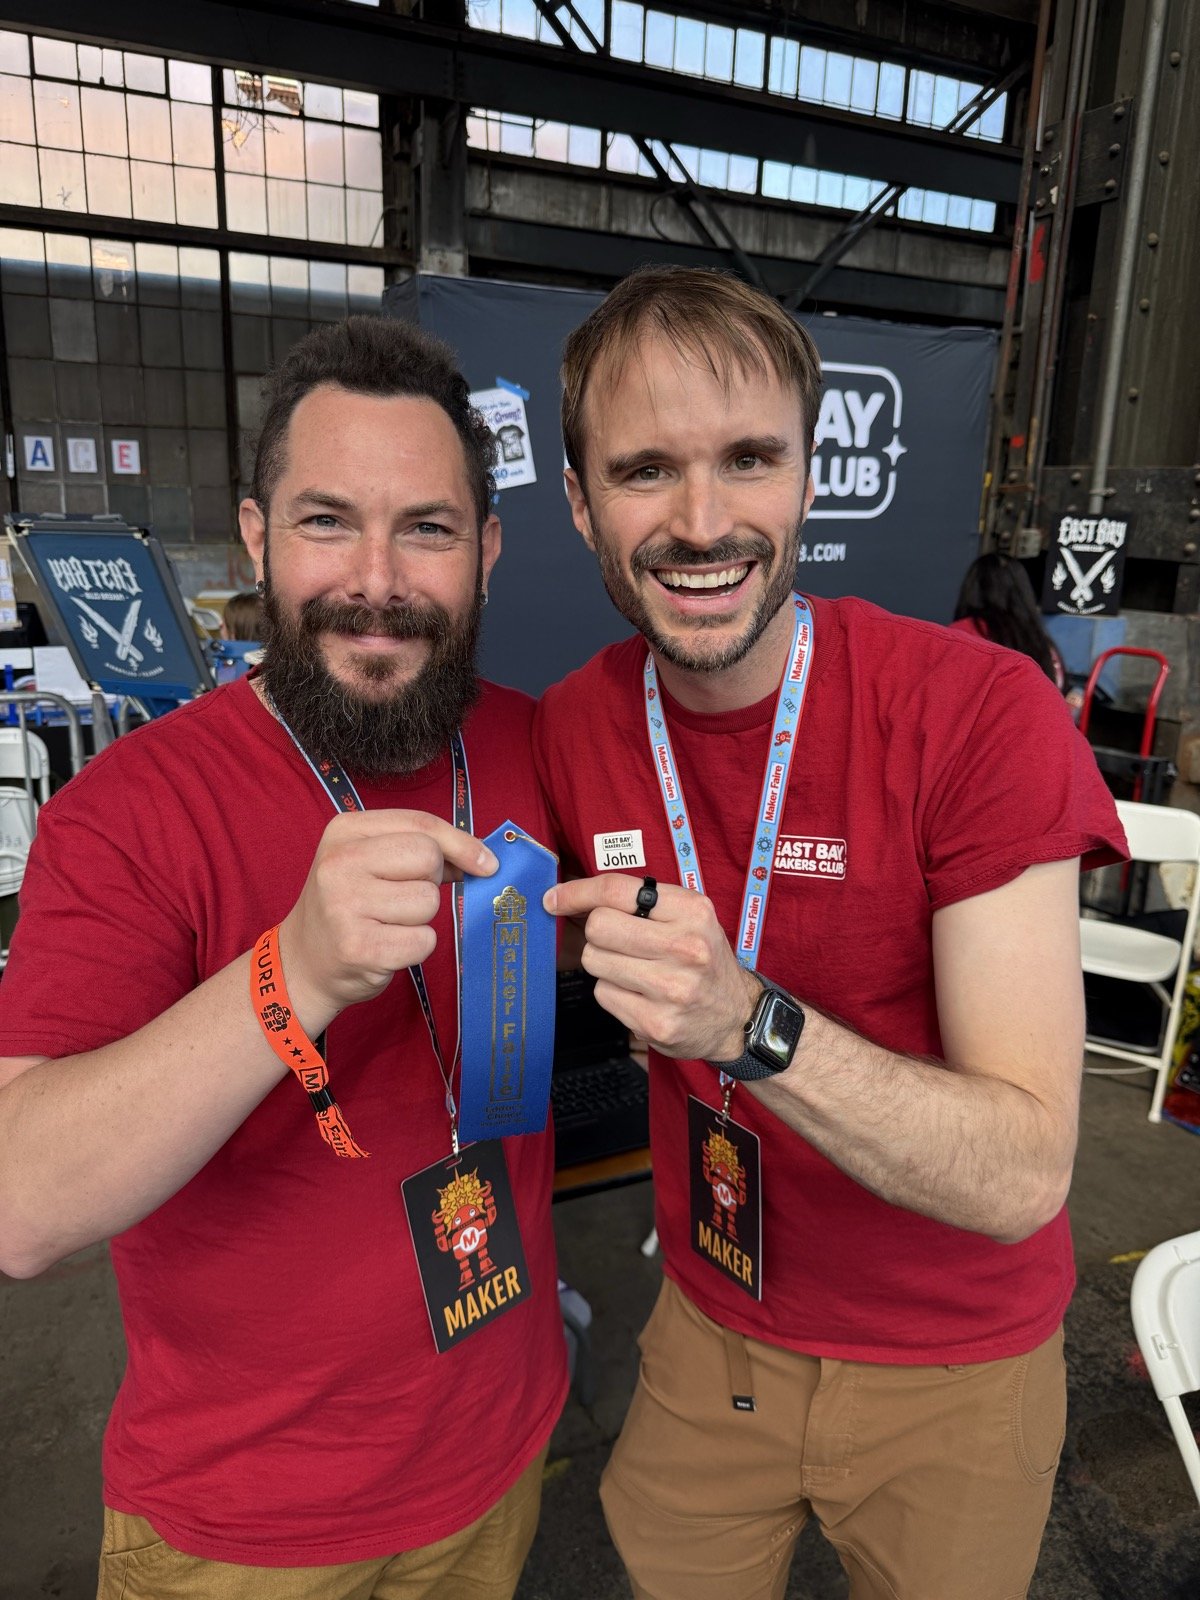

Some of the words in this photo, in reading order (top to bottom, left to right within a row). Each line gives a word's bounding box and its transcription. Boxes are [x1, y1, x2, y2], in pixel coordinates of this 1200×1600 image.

[814, 389, 885, 448] AY
[30, 439, 50, 467] A
[118, 443, 132, 469] E
[810, 455, 881, 497] LUB
[799, 543, 847, 562] B.COM
[798, 624, 809, 647] Faire
[791, 649, 806, 681] Maker
[657, 746, 670, 775] Maker
[664, 776, 675, 799] Faire
[770, 765, 783, 790] Faire
[765, 790, 778, 821] Maker
[603, 852, 637, 867] John
[815, 843, 845, 861] BAY
[818, 861, 844, 874] CLUB
[748, 896, 760, 919] Faire
[744, 919, 757, 950] Maker
[698, 1220, 753, 1287] MAKER
[443, 1266, 522, 1338] MAKER
